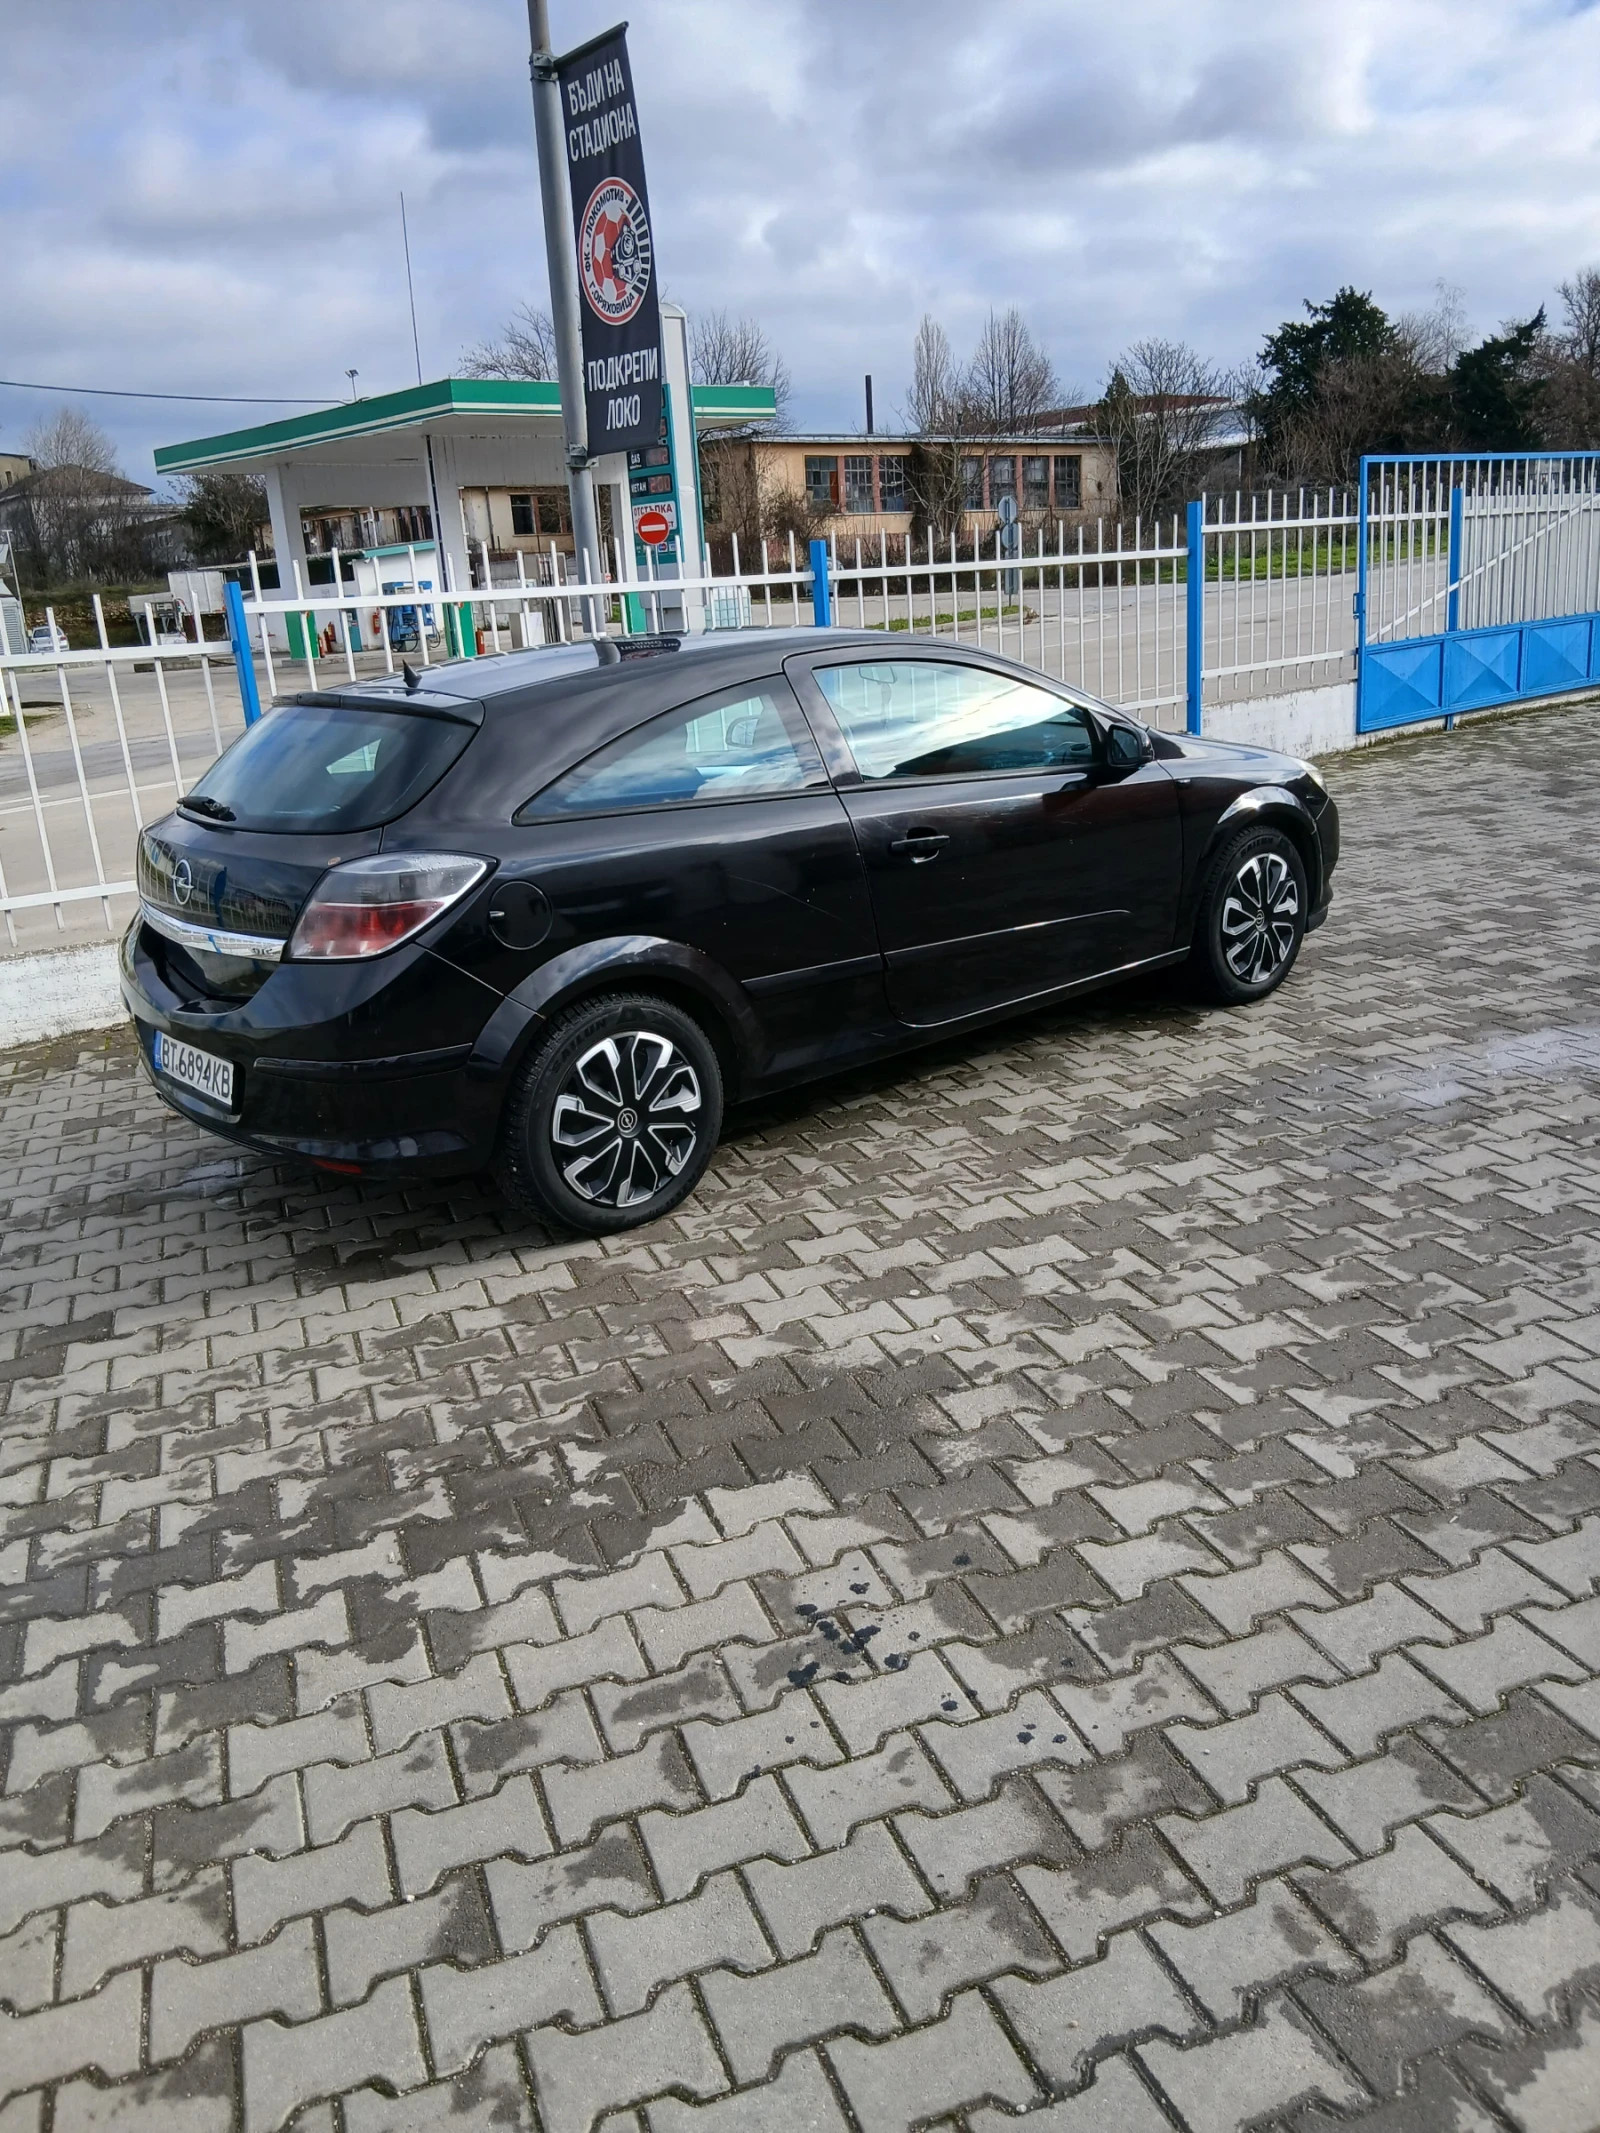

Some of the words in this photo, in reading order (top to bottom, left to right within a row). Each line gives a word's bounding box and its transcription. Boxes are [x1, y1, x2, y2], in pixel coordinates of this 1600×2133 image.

[567, 67, 606, 116] БЪДИ
[603, 58, 625, 98] НА
[569, 102, 637, 162] СТАДИОНА
[585, 187, 625, 238] ЛОКОМОТИВ
[584, 251, 591, 272] ФК
[587, 347, 658, 392] ПОДКРЕПИ
[606, 394, 641, 431] ЛОКО
